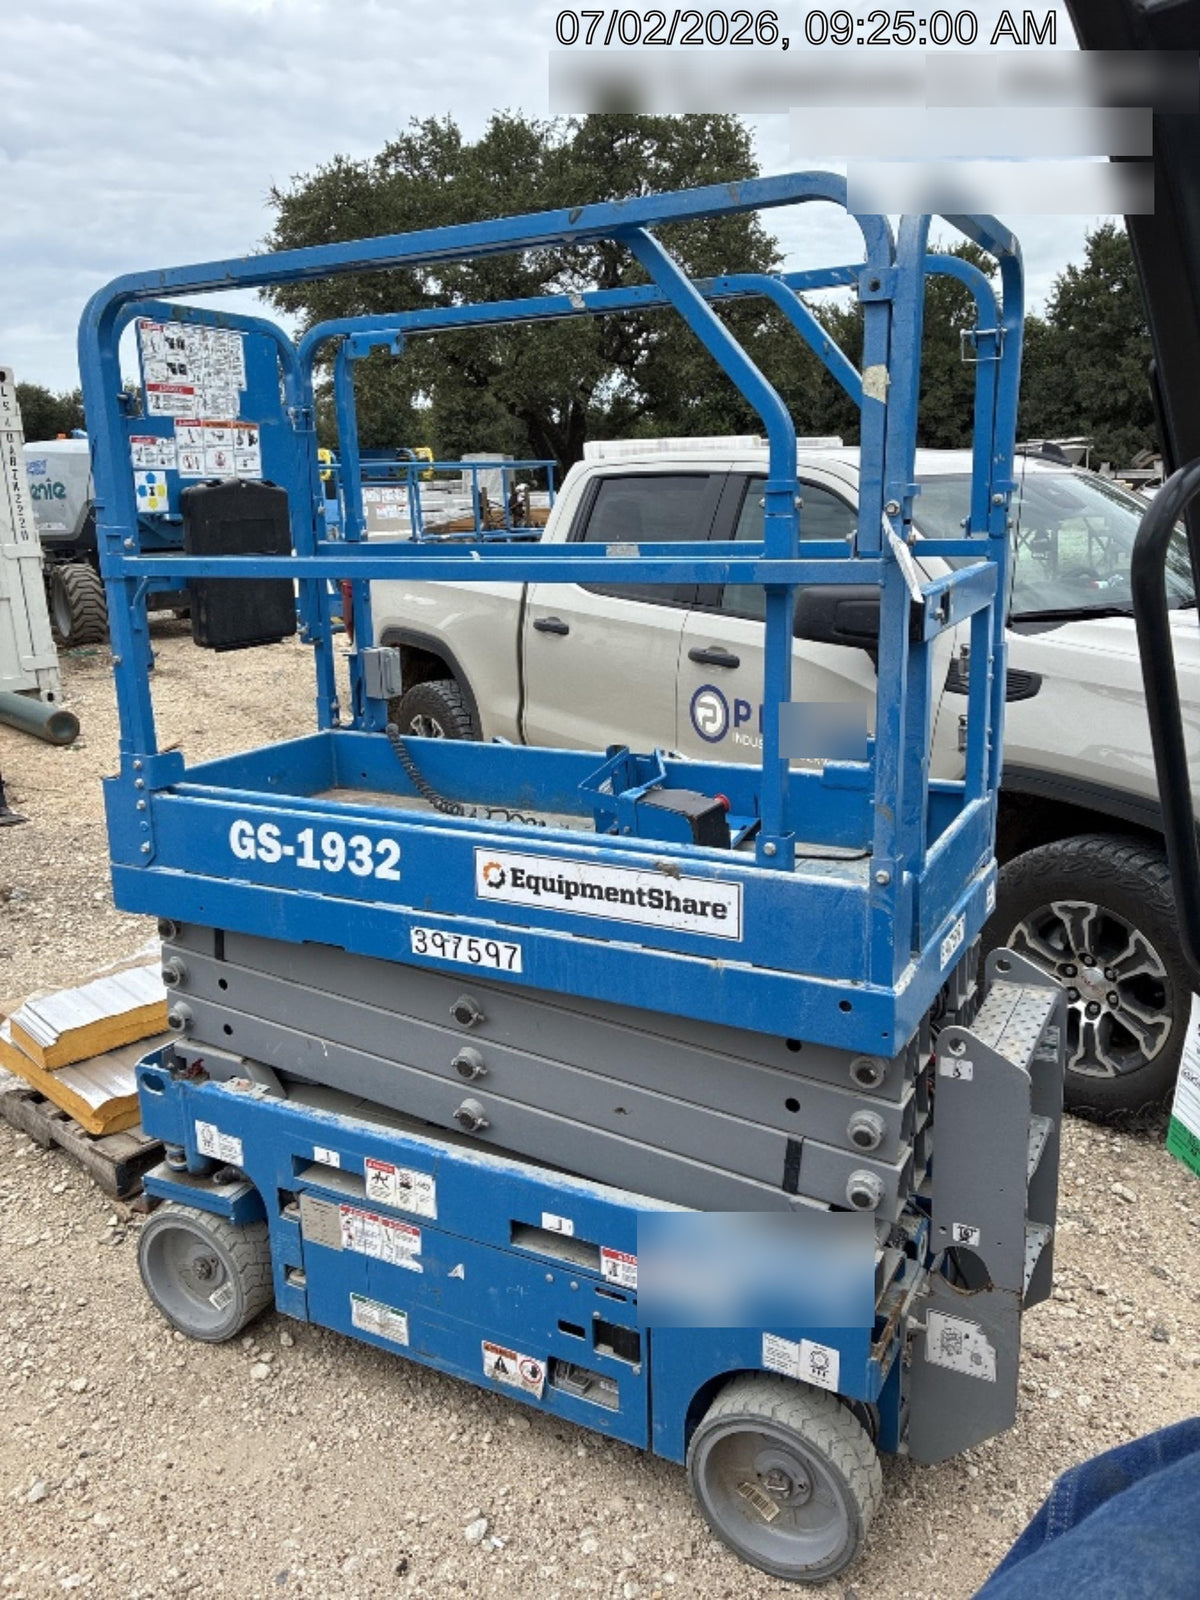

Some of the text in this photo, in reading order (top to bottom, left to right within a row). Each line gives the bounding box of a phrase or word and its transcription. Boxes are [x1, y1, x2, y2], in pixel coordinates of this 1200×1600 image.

[31, 477, 67, 500] enie
[229, 819, 401, 881] GS-1932
[510, 867, 729, 920] EquipmentShare
[414, 929, 518, 970] 397597
